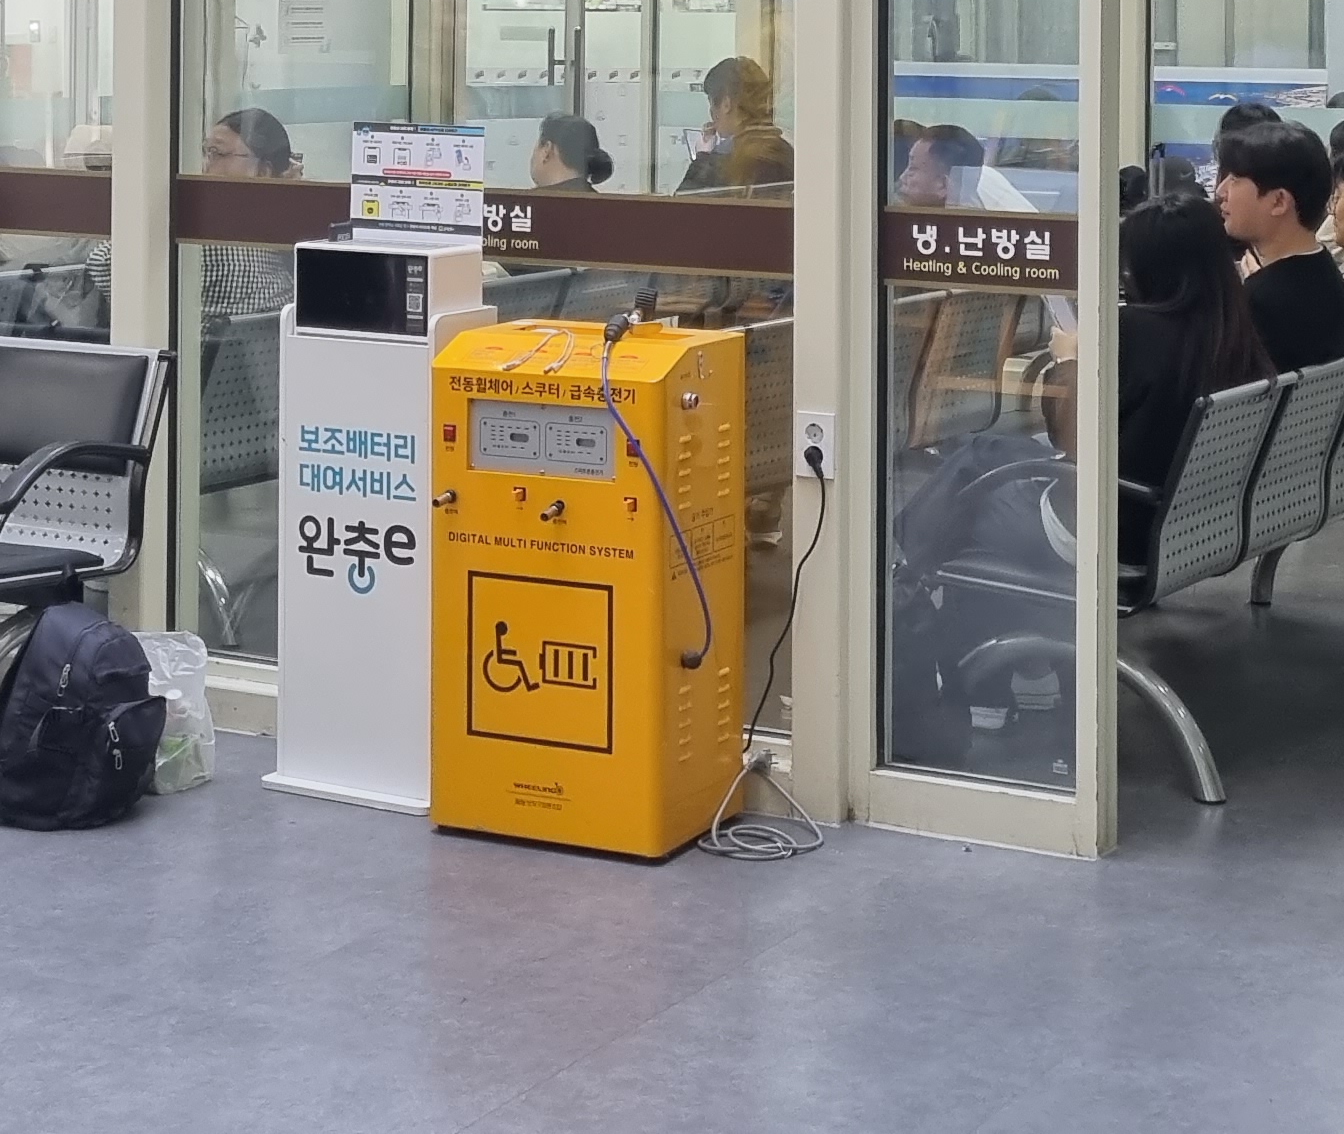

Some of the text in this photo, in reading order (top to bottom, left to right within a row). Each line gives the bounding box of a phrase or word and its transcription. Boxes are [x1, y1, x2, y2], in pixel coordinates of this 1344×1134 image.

[511, 239, 539, 250] room
[912, 224, 1051, 261] 냉.난방실
[903, 257, 1059, 280] Heating & Cooling room
[521, 380, 560, 399] 스쿠터
[299, 425, 416, 464] 보조배터리
[299, 463, 417, 502] 대여서비스
[448, 531, 634, 559] DIGITAL MULTI FUNCTION SYSTEM
